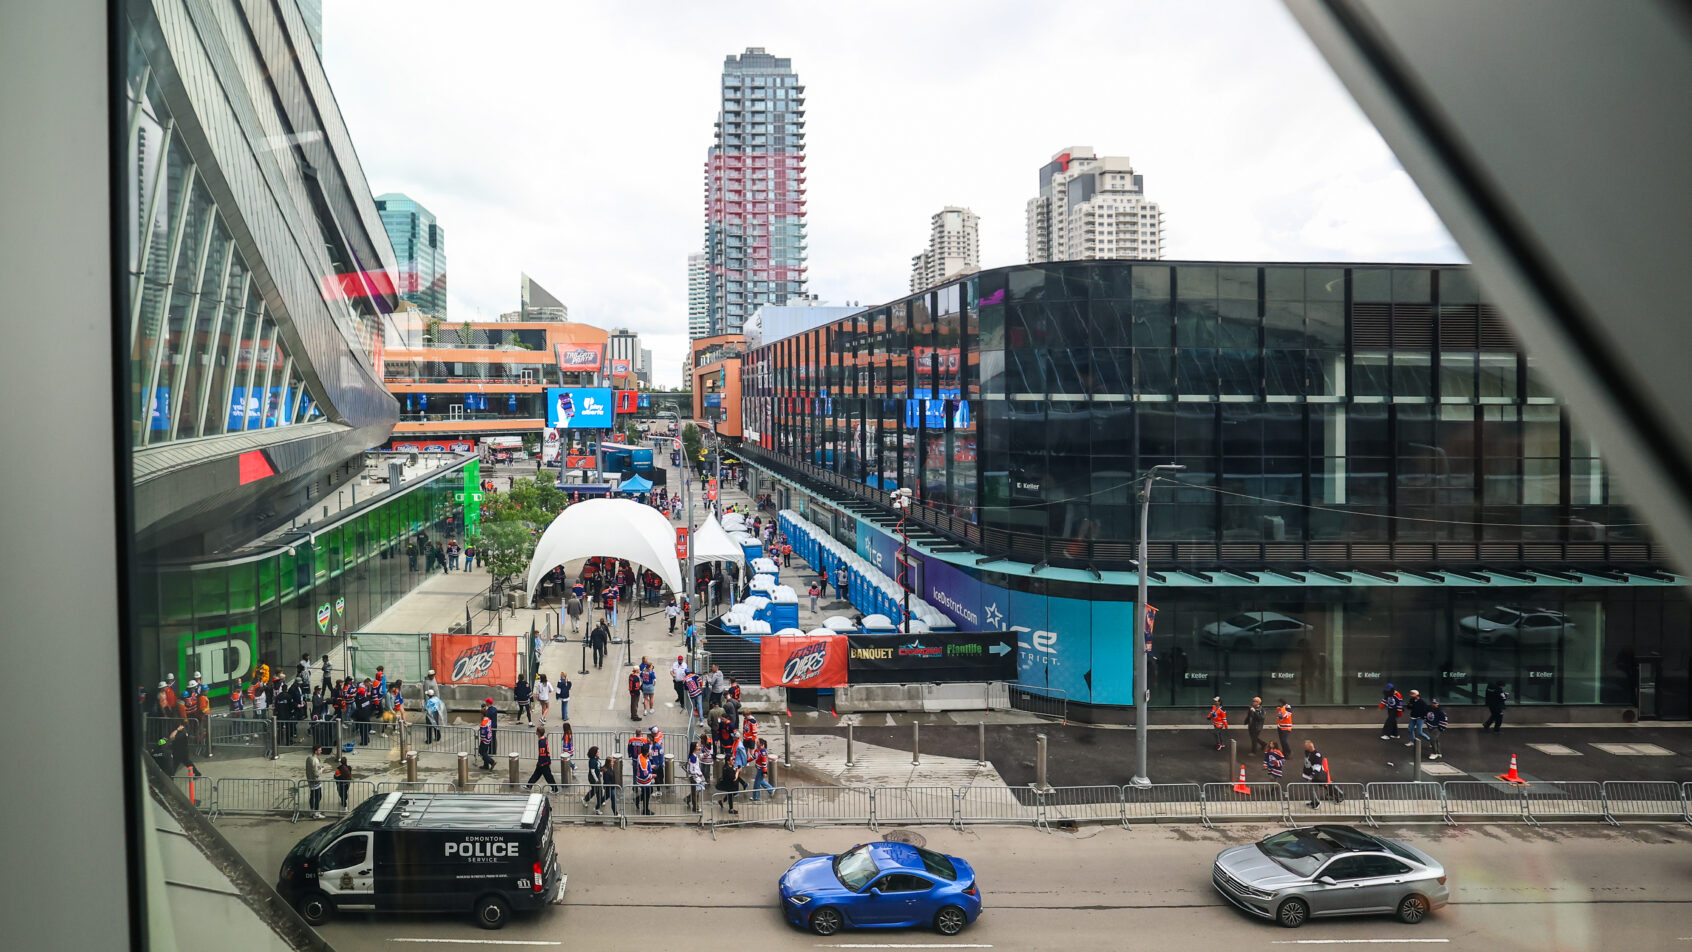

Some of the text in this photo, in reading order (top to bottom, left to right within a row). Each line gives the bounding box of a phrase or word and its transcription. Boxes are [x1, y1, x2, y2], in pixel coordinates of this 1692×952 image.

[1023, 482, 1039, 490] Keller
[933, 585, 978, 626] IceDistrict.com
[851, 648, 893, 660] BANQUET
[947, 644, 982, 654] Plantlife
[186, 638, 251, 685] TD
[445, 842, 519, 856] POLICE
